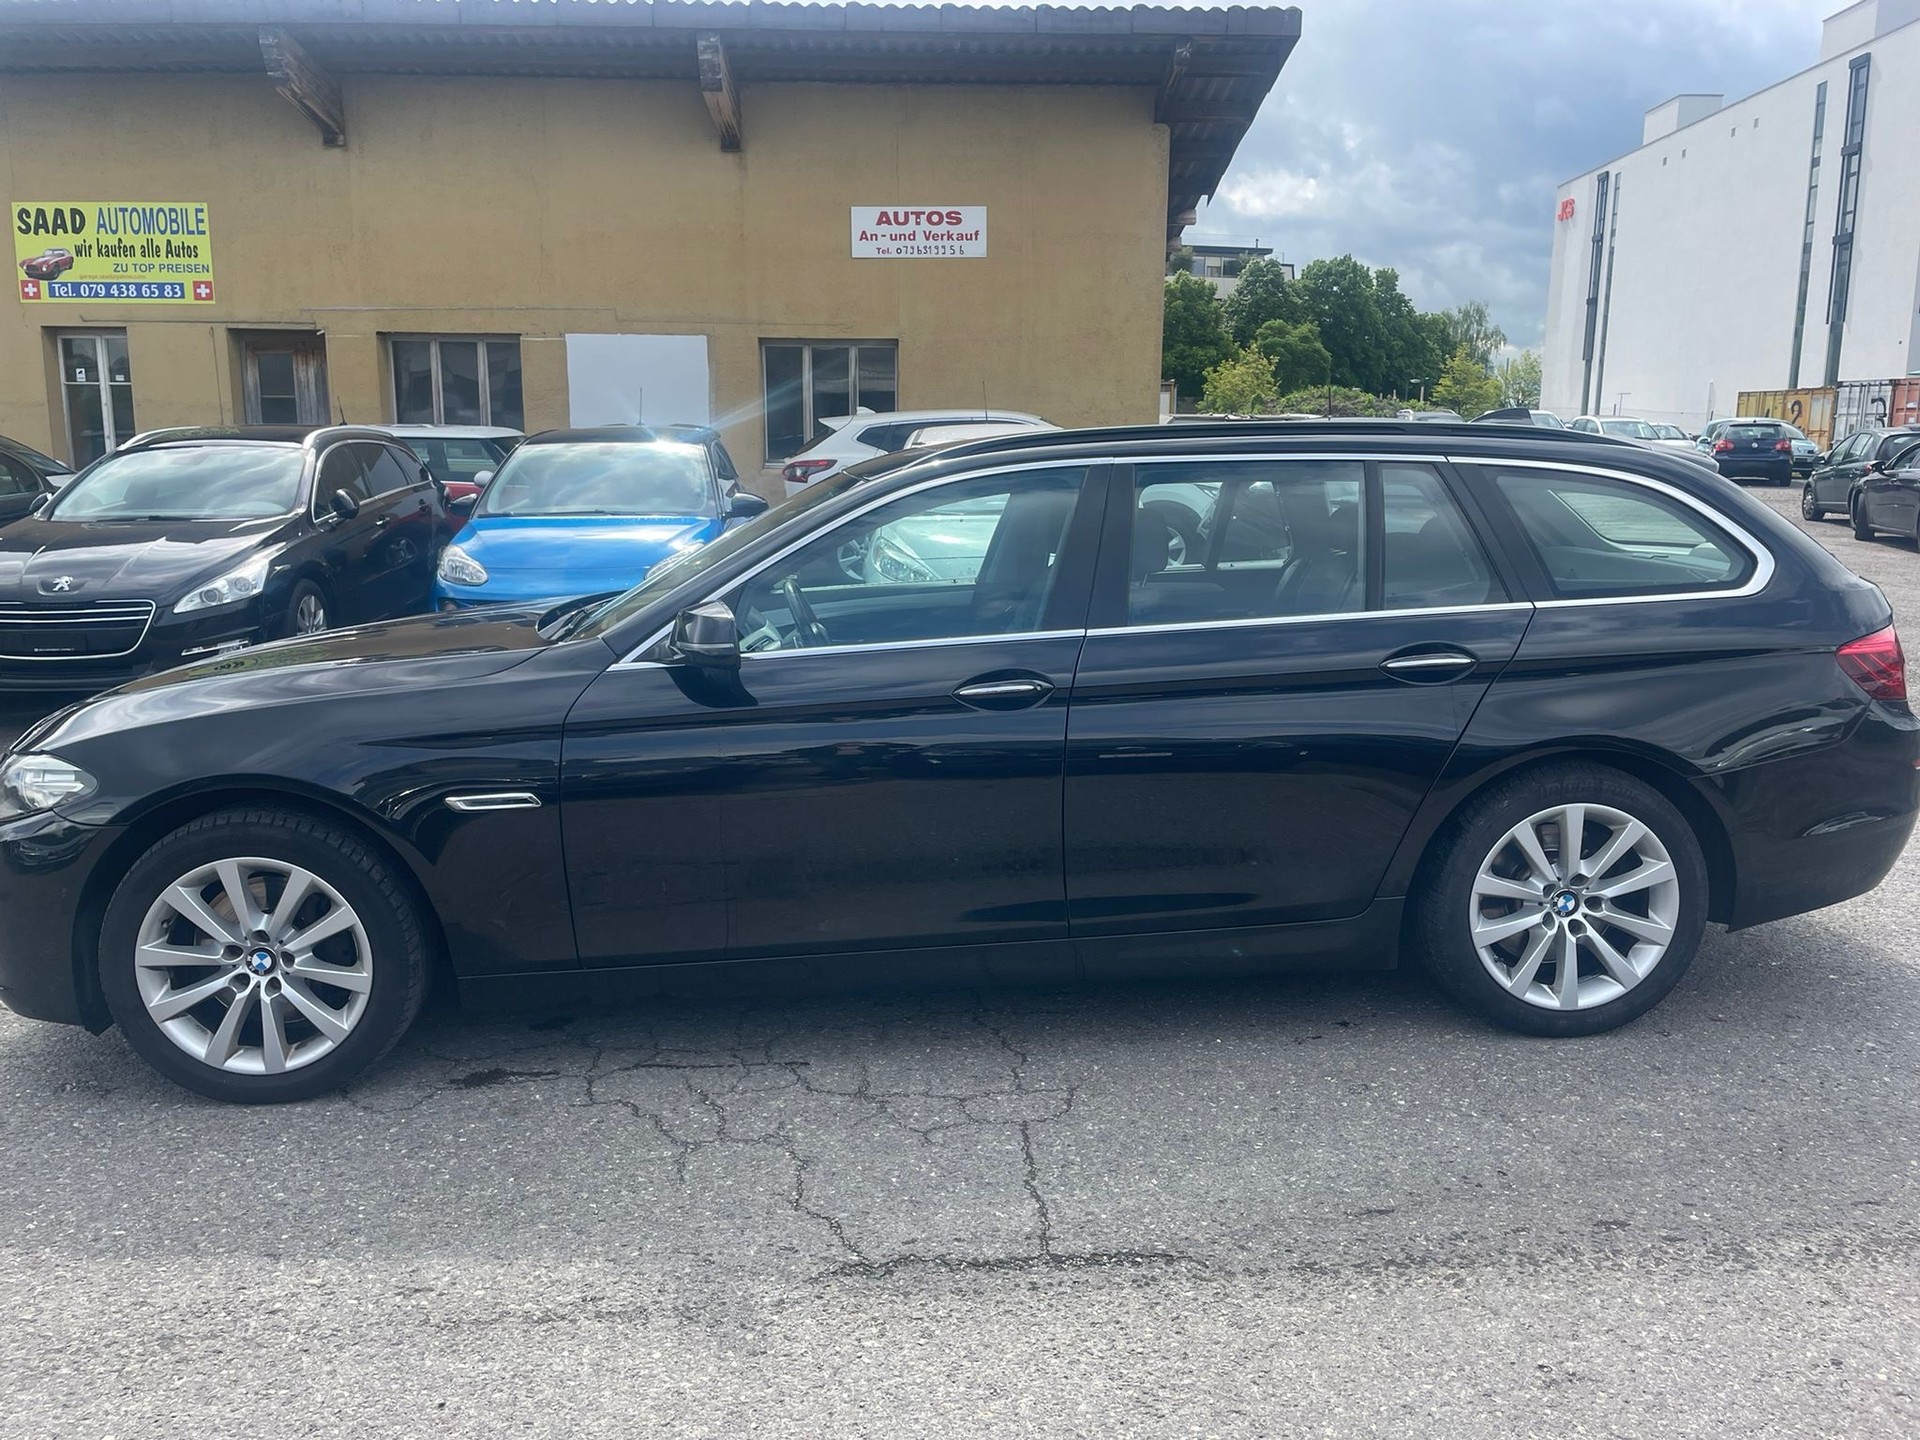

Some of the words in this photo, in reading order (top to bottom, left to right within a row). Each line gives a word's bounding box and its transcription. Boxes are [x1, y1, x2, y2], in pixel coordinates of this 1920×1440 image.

[17, 207, 86, 236] SAAD
[96, 207, 207, 235] AUTOMOBILE
[876, 210, 963, 226] AUTOS
[923, 230, 980, 241] Verkauf
[74, 239, 92, 258] wir
[97, 238, 136, 258] kaufen
[140, 239, 161, 258] alle
[165, 239, 199, 259] Autos
[876, 247, 892, 255] Tel.
[113, 263, 129, 273] ZU
[133, 263, 156, 273] TOP
[158, 263, 210, 274] PREISEN
[52, 284, 76, 297] Tel.
[80, 284, 105, 297] 079
[110, 284, 137, 297] 438
[141, 284, 159, 297] 65
[164, 284, 181, 298] 83
